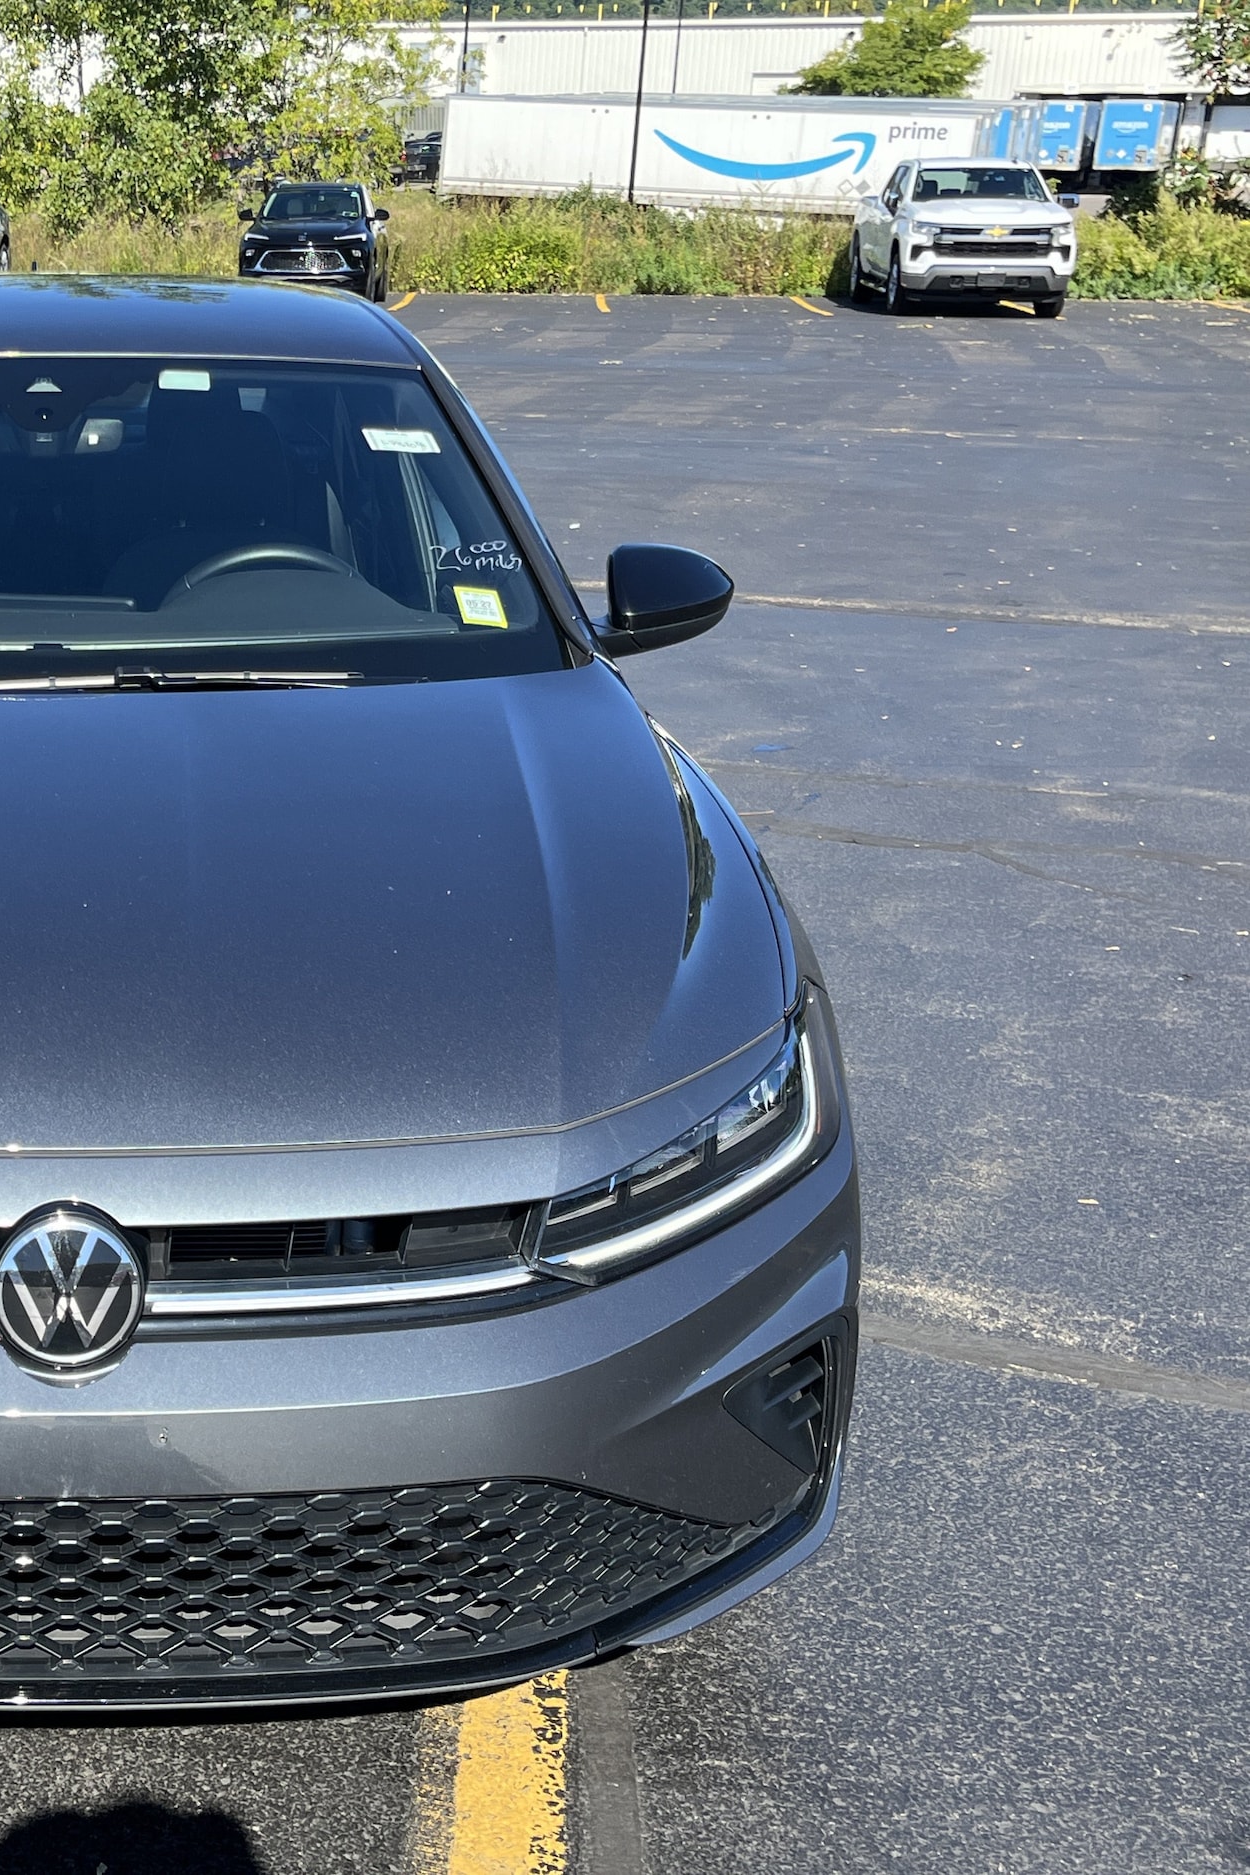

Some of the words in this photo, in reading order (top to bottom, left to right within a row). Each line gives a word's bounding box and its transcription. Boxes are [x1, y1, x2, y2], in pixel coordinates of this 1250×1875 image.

[888, 121, 948, 143] prime
[429, 545, 472, 571] 26
[469, 540, 507, 553] 000
